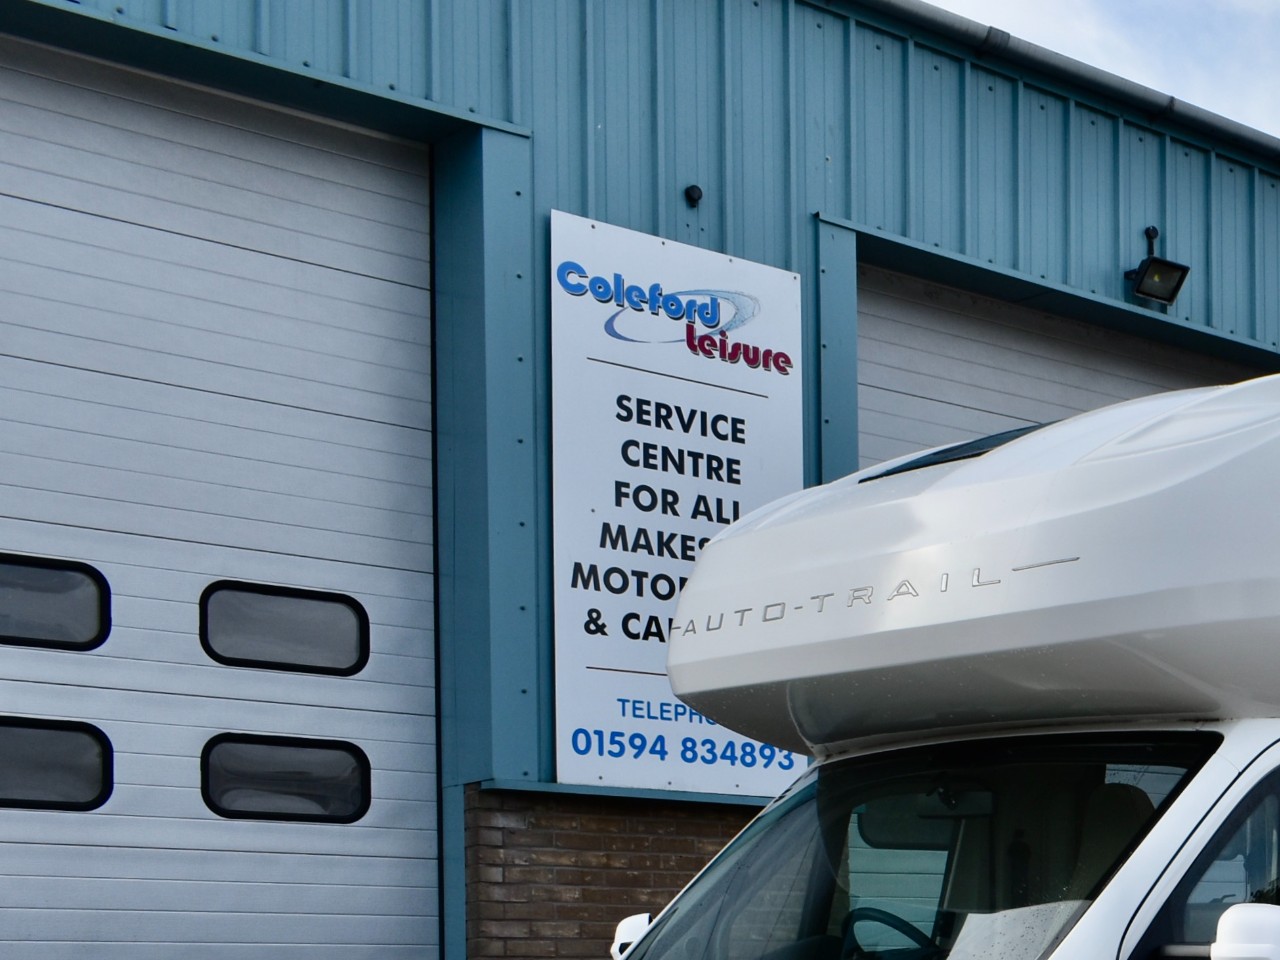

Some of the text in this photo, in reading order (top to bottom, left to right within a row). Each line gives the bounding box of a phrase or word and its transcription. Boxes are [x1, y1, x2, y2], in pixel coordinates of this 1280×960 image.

[556, 260, 721, 328] Coleford
[615, 394, 746, 444] SERVICE
[620, 439, 742, 485] CENTRE
[614, 480, 680, 517] FOR
[570, 561, 689, 601] MOTO
[682, 567, 1001, 637] AUTO-TRAIL
[583, 607, 673, 643] & CA
[571, 728, 795, 771] 01594 834893
